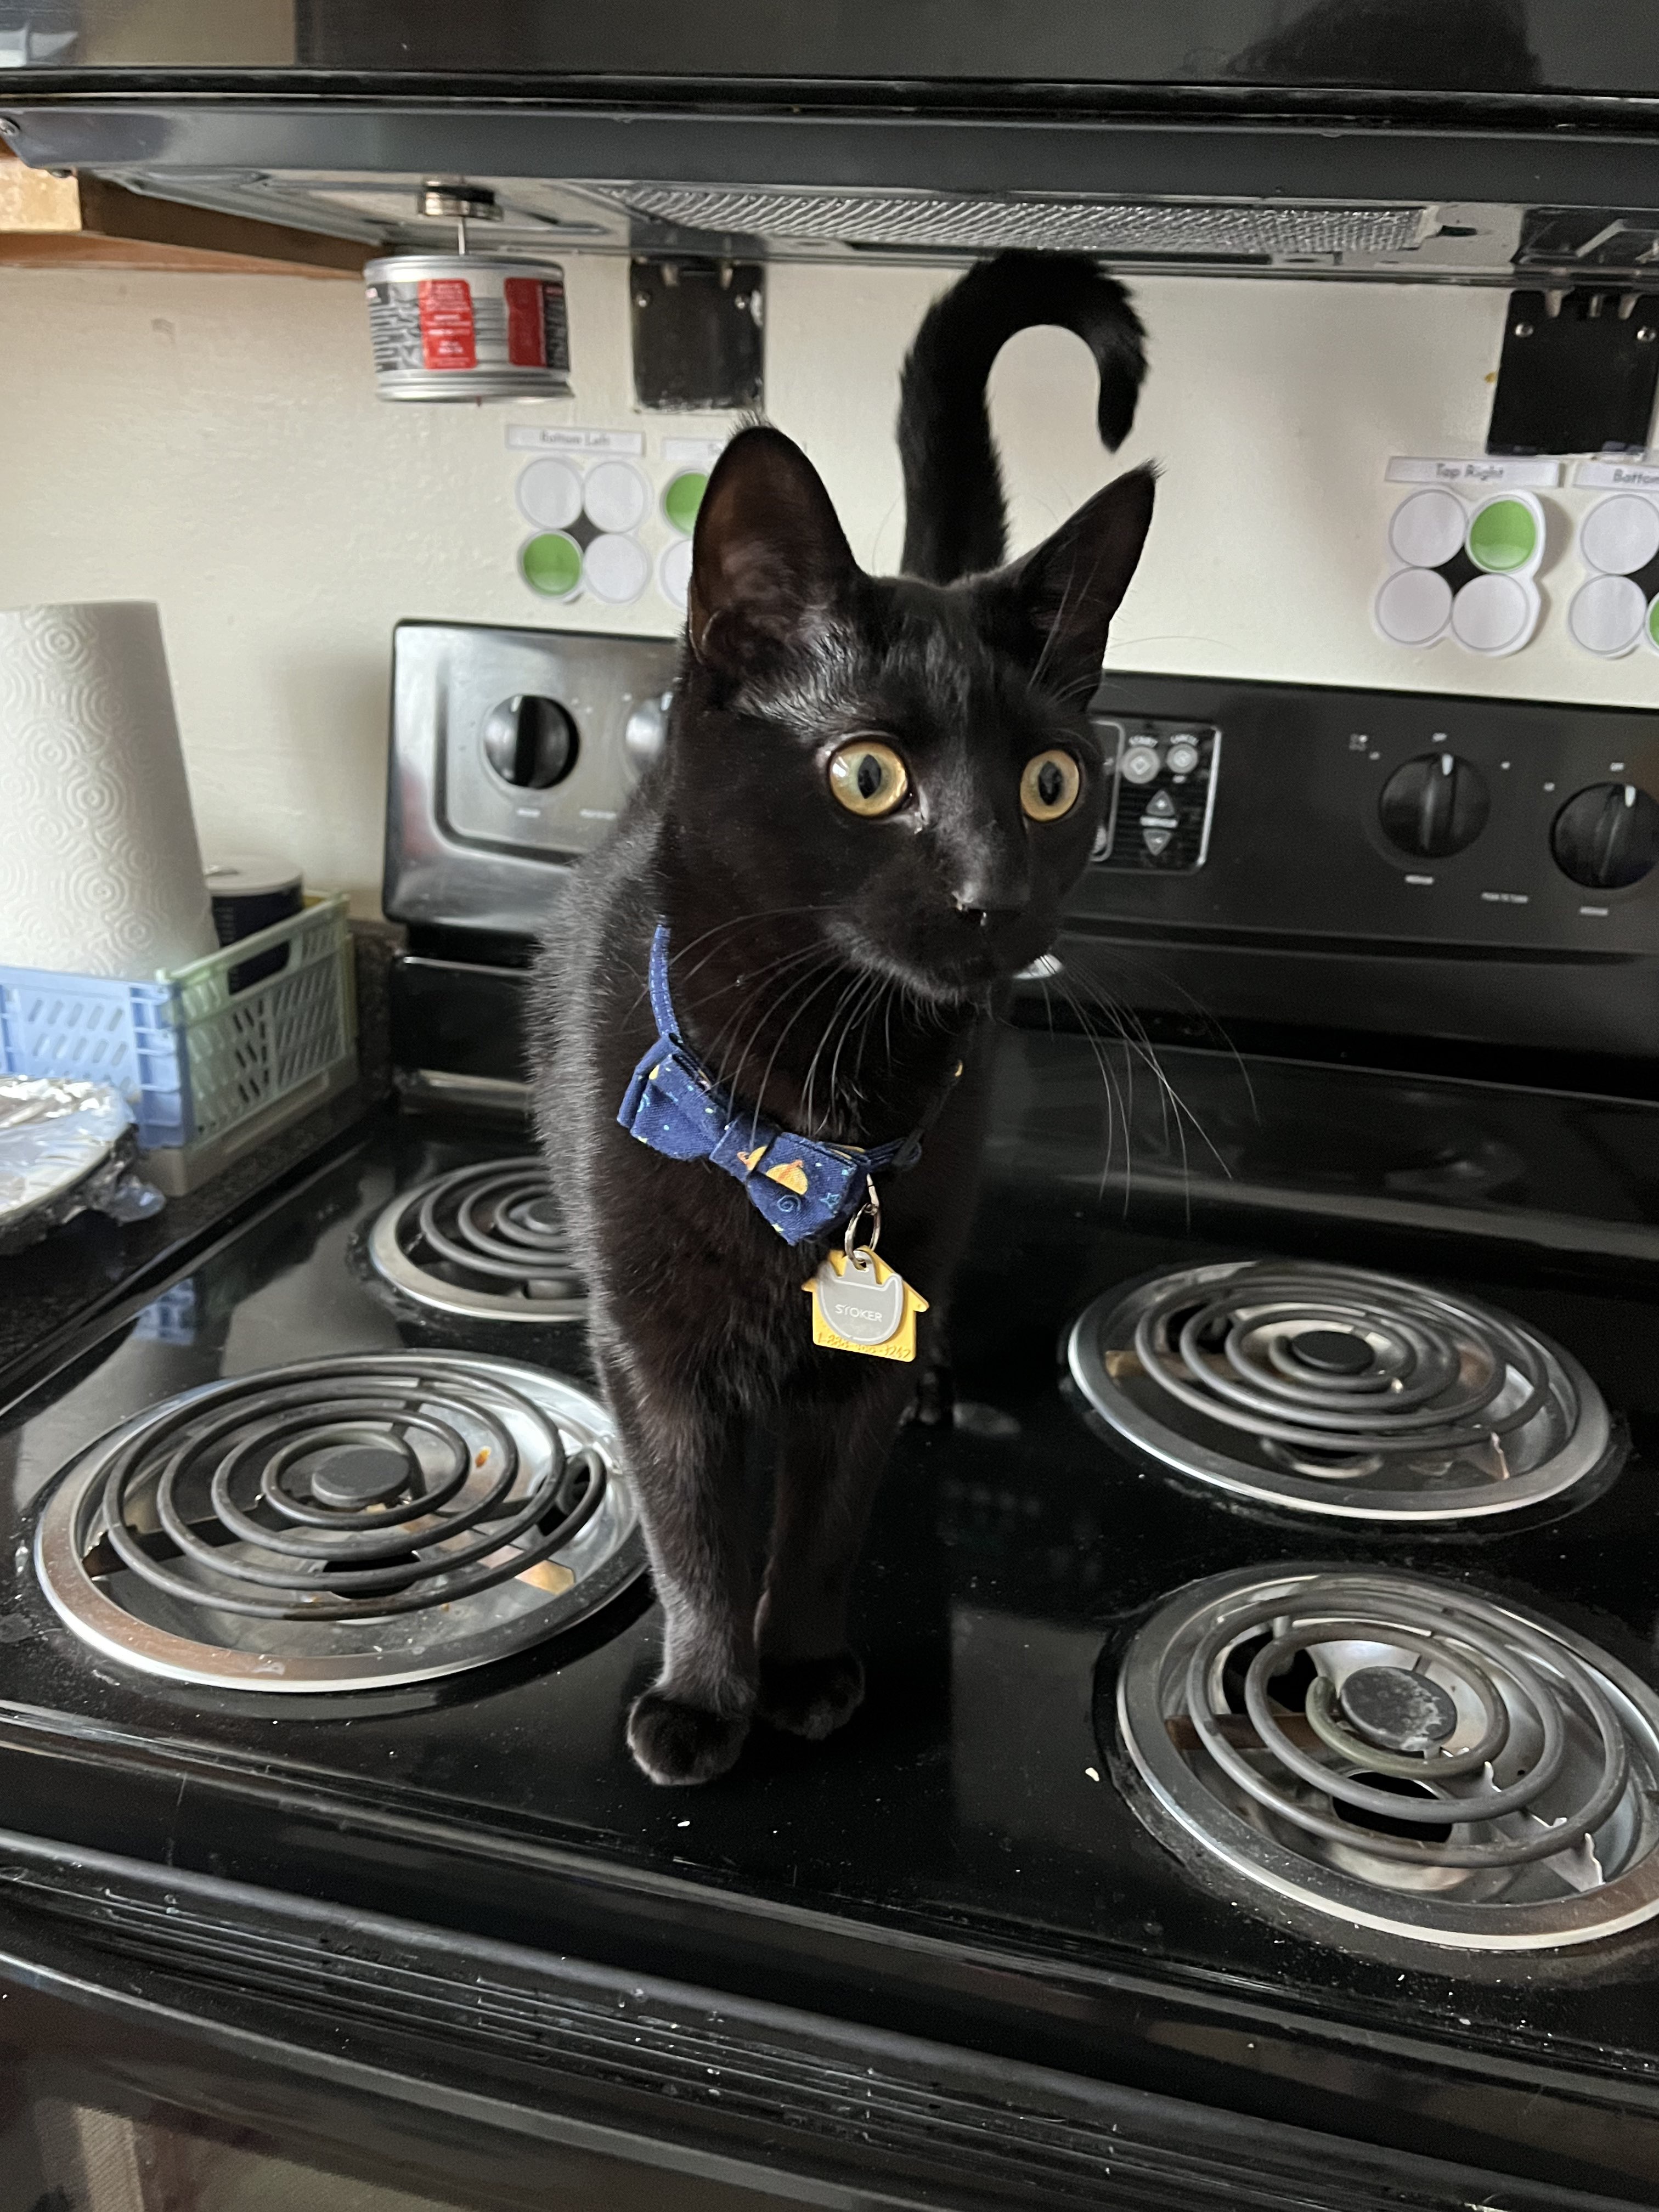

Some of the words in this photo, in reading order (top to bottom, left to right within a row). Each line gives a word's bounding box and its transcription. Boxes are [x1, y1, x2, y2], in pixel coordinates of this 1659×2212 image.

[1436, 463, 1460, 479] Top
[1465, 464, 1504, 481] Right
[834, 1304, 882, 1322] STOKER
